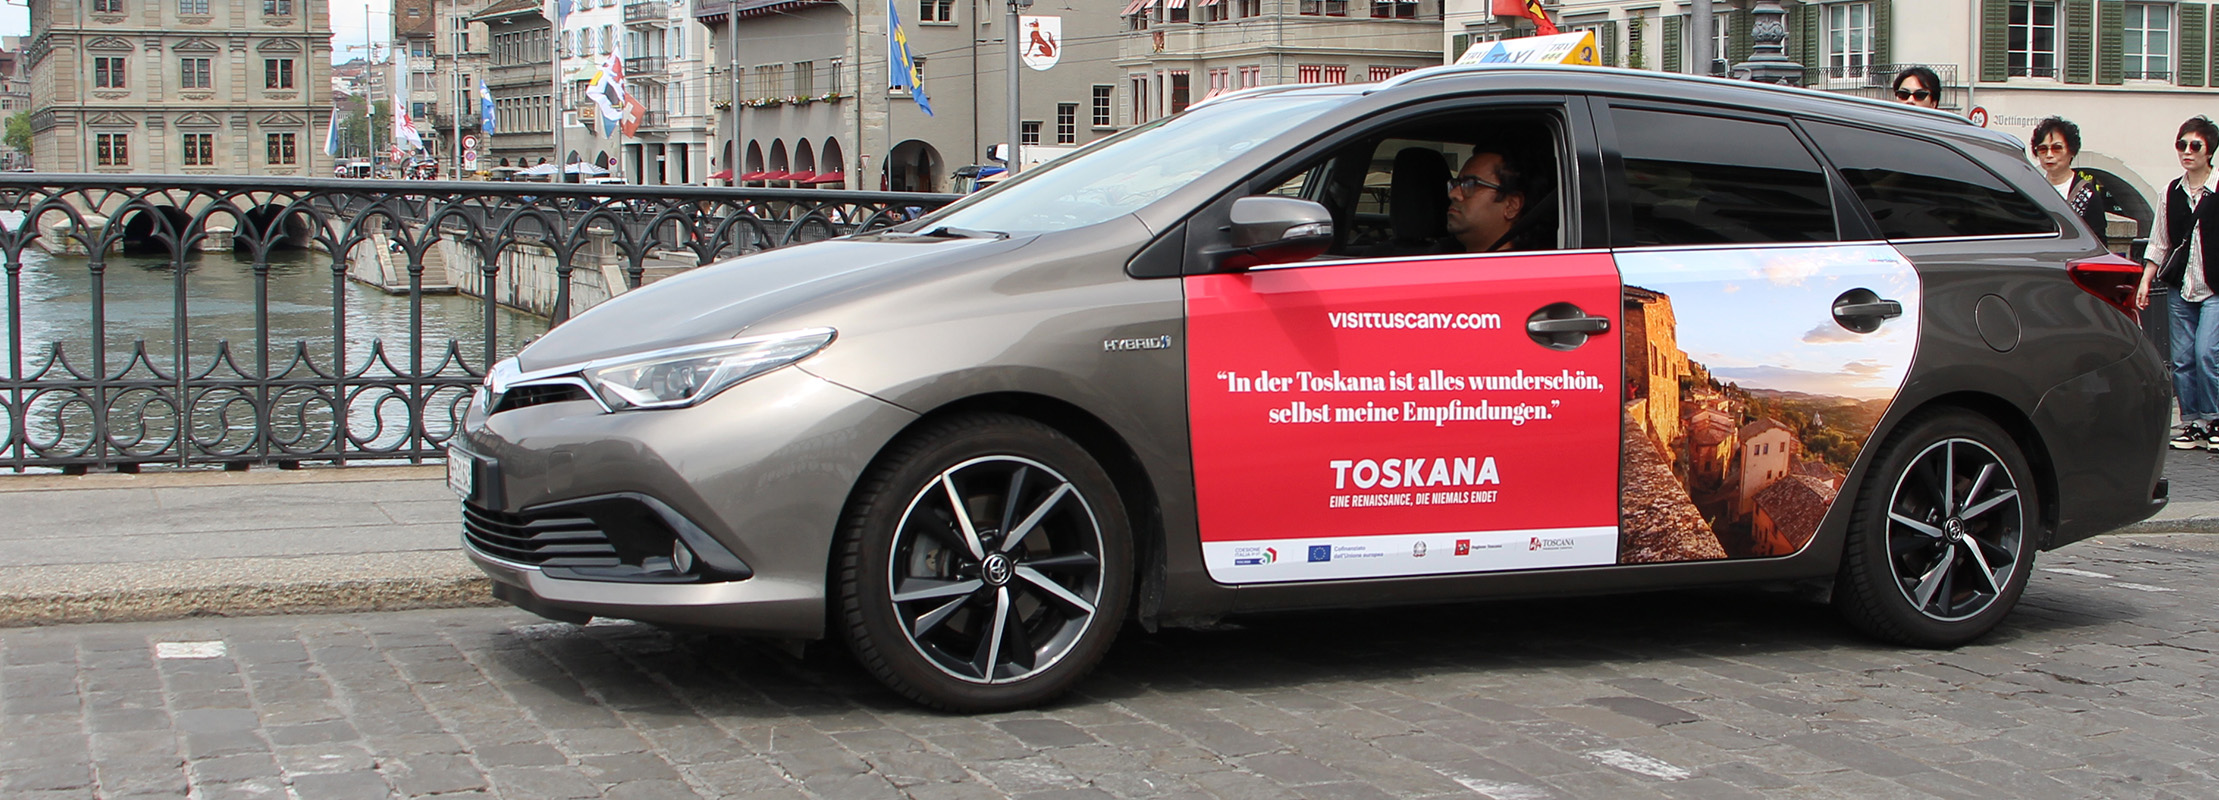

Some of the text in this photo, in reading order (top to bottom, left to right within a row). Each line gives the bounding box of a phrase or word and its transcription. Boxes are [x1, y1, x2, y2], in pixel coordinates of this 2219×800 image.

[1490, 50, 1535, 63] TAXI
[1104, 337, 1160, 350] HYBRID
[1254, 370, 1293, 392] der
[1296, 370, 1386, 392] Toskana
[1389, 370, 1415, 391] ist
[1418, 370, 1465, 391] alles
[1468, 369, 1604, 393] wunderschön,
[1268, 399, 1560, 427] selbst meine Empfindungen.”
[1329, 456, 1500, 489] TOSKANA
[1329, 490, 1498, 508] EINE RENAISSANCE, DIE NIEMALS ENDET
[1542, 538, 1574, 547] TOSCANA
